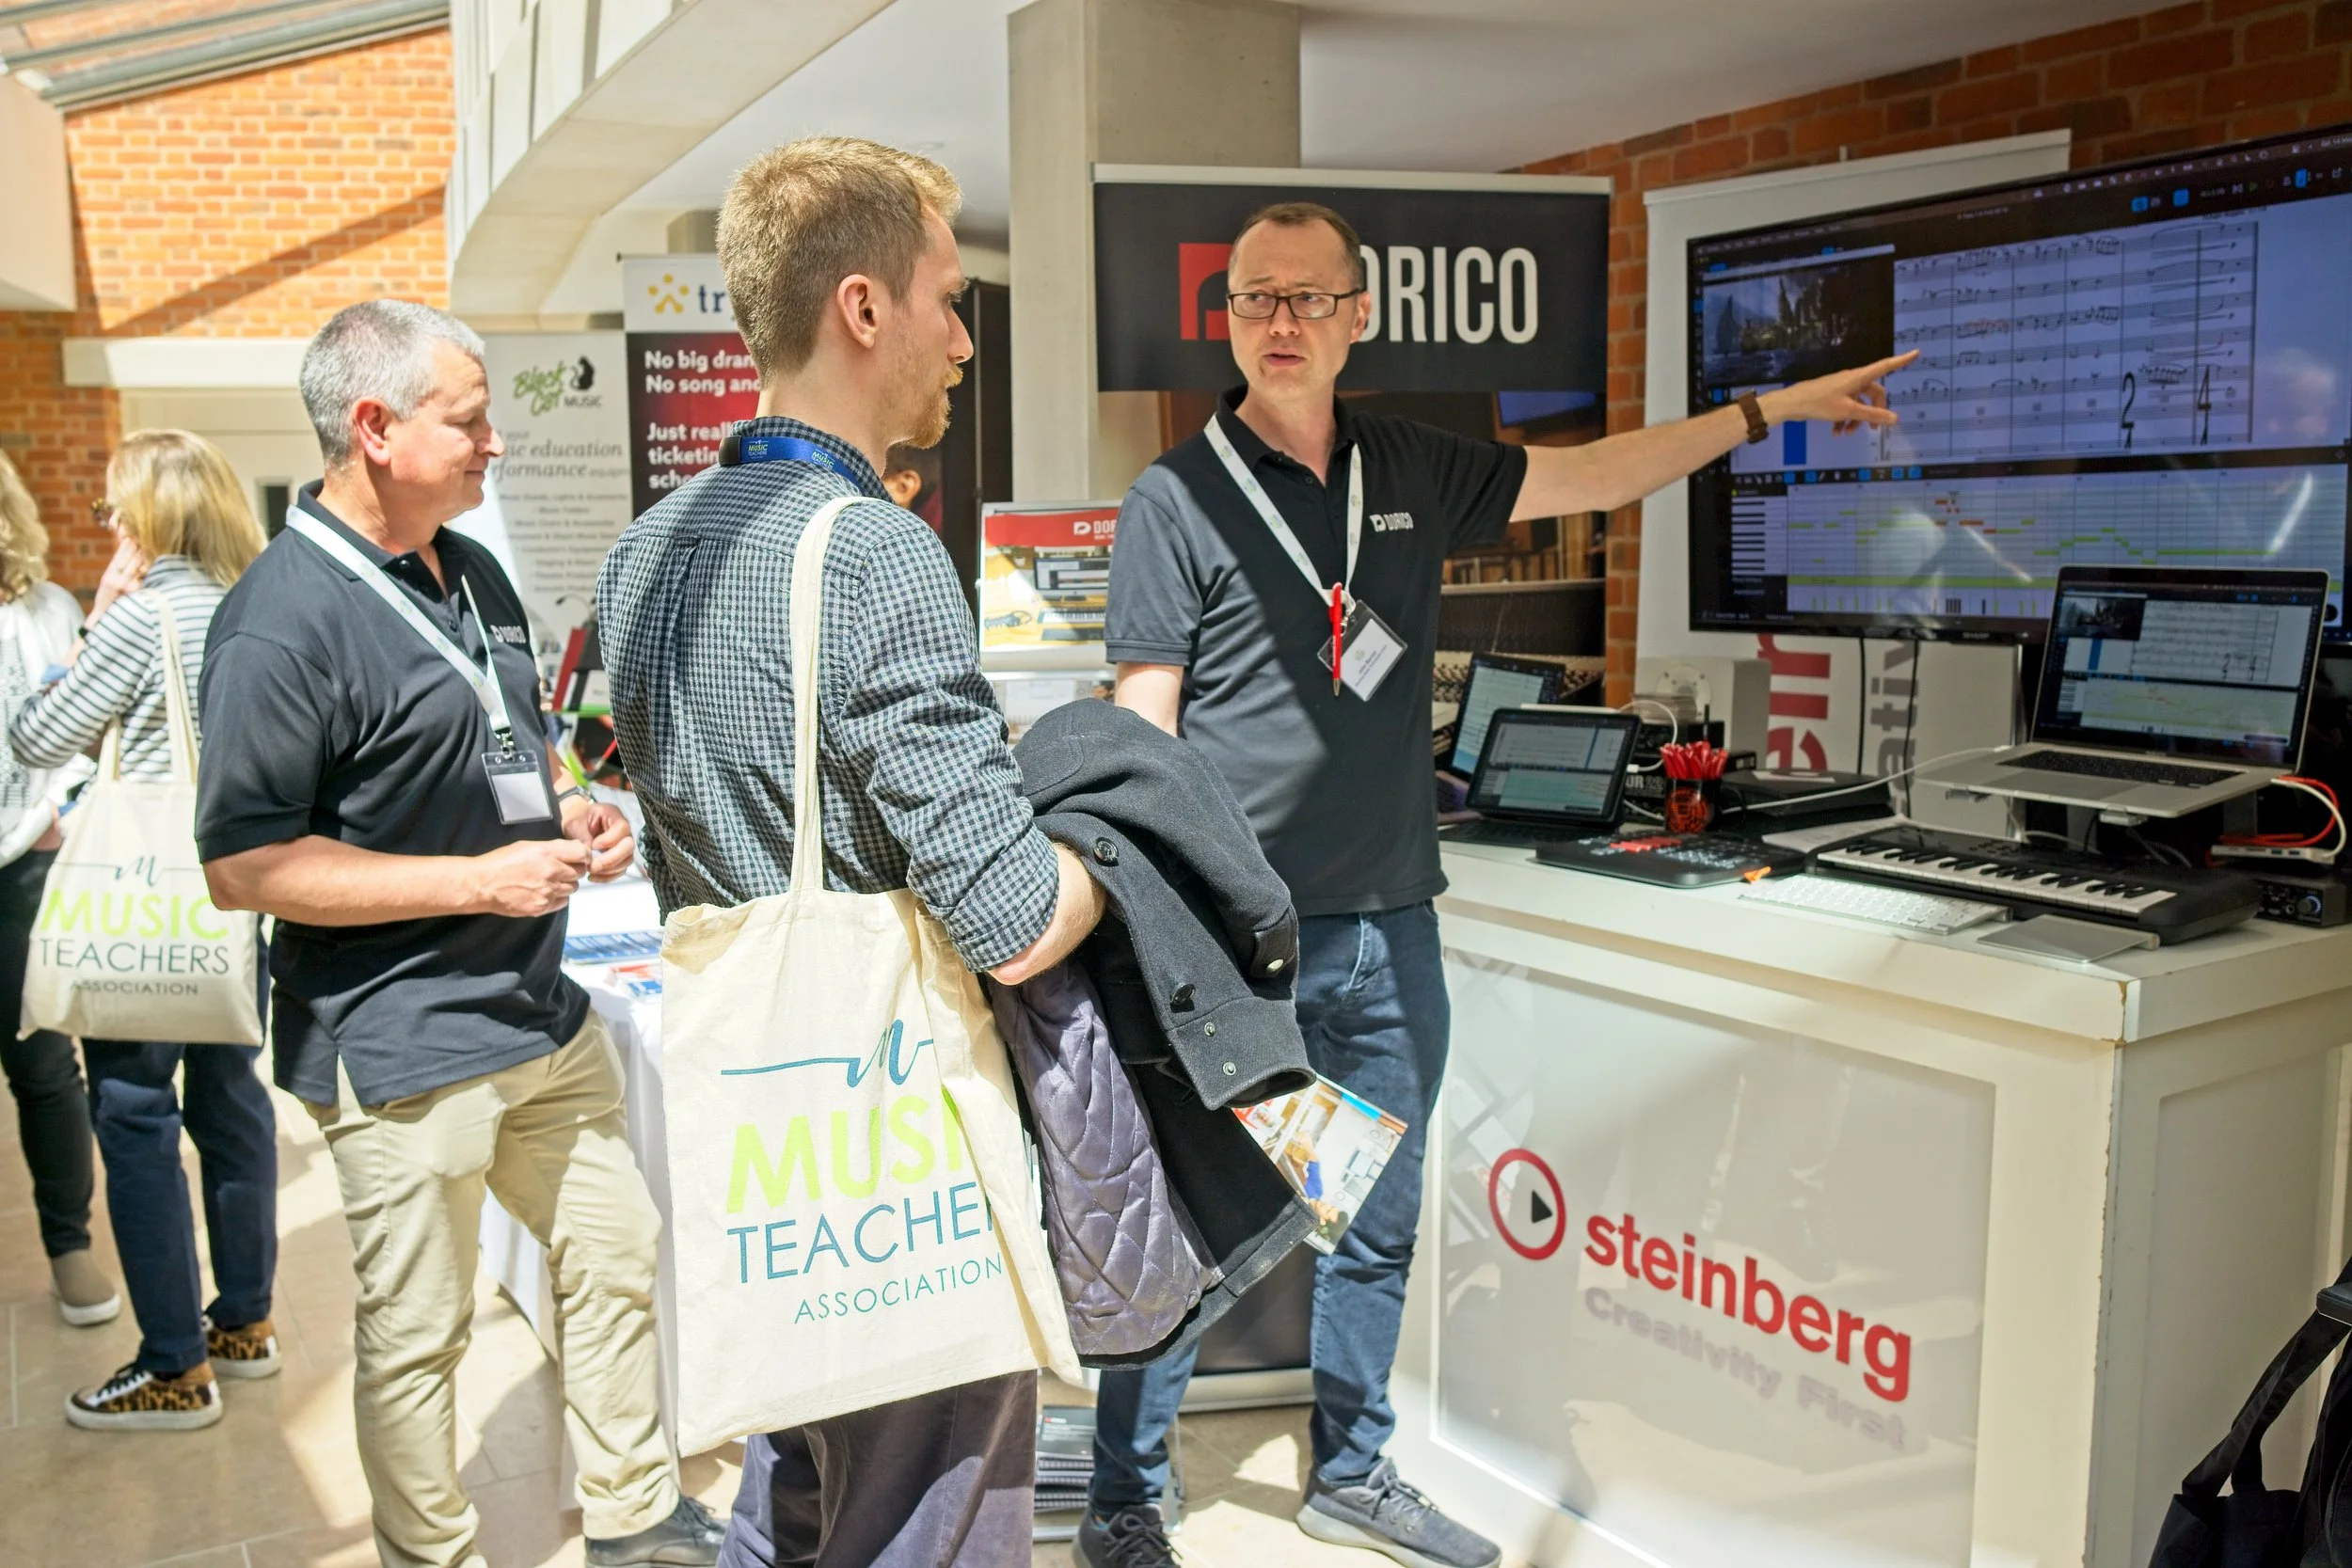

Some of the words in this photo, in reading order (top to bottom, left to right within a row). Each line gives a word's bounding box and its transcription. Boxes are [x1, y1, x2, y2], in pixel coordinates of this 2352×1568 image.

[644, 350, 675, 369] No
[677, 349, 708, 373] big
[645, 374, 675, 393] No
[678, 378, 725, 398] song
[564, 395, 602, 408] MUSIC
[646, 422, 687, 441] Just
[691, 420, 732, 441] reall
[529, 436, 623, 458] education
[648, 445, 719, 466] ticketin
[748, 443, 769, 451] MUSIC
[812, 451, 834, 467] MUSIC
[492, 457, 588, 483] rformance
[1093, 519, 1118, 534] DOR
[40, 888, 230, 941] MUSIC
[40, 938, 230, 975] TEACHERS
[71, 978, 199, 996] ASSOCIATION
[726, 1093, 963, 1214] MUSI
[726, 1180, 993, 1284] TEACHE
[793, 1252, 1002, 1324] ASSOCIATION
[1584, 1212, 1912, 1402] steinberg
[1584, 1286, 1783, 1400] Creativity
[1797, 1370, 1906, 1452] First
